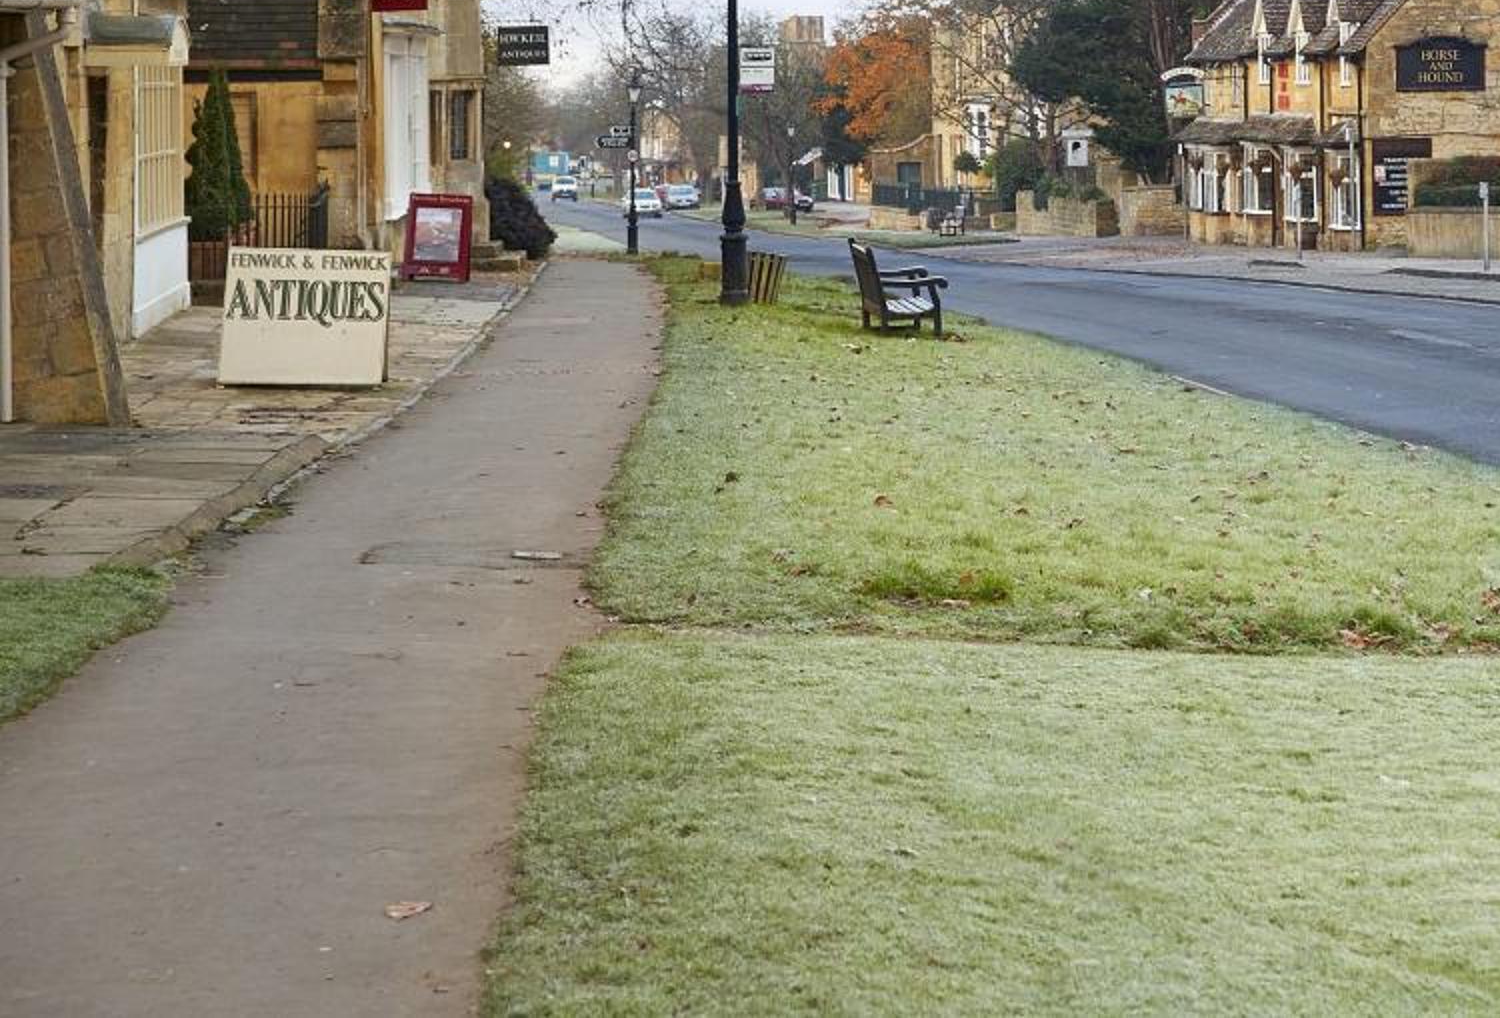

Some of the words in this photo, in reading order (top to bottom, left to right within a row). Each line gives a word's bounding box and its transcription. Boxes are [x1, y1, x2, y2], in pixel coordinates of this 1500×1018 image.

[1421, 49, 1463, 61] HORSE
[1430, 62, 1455, 71] AND
[1417, 71, 1464, 83] HOUND
[231, 253, 298, 269] FENWICK
[302, 254, 315, 270] &
[321, 255, 387, 271] FENWICK
[226, 278, 385, 328] ANTIQUES
